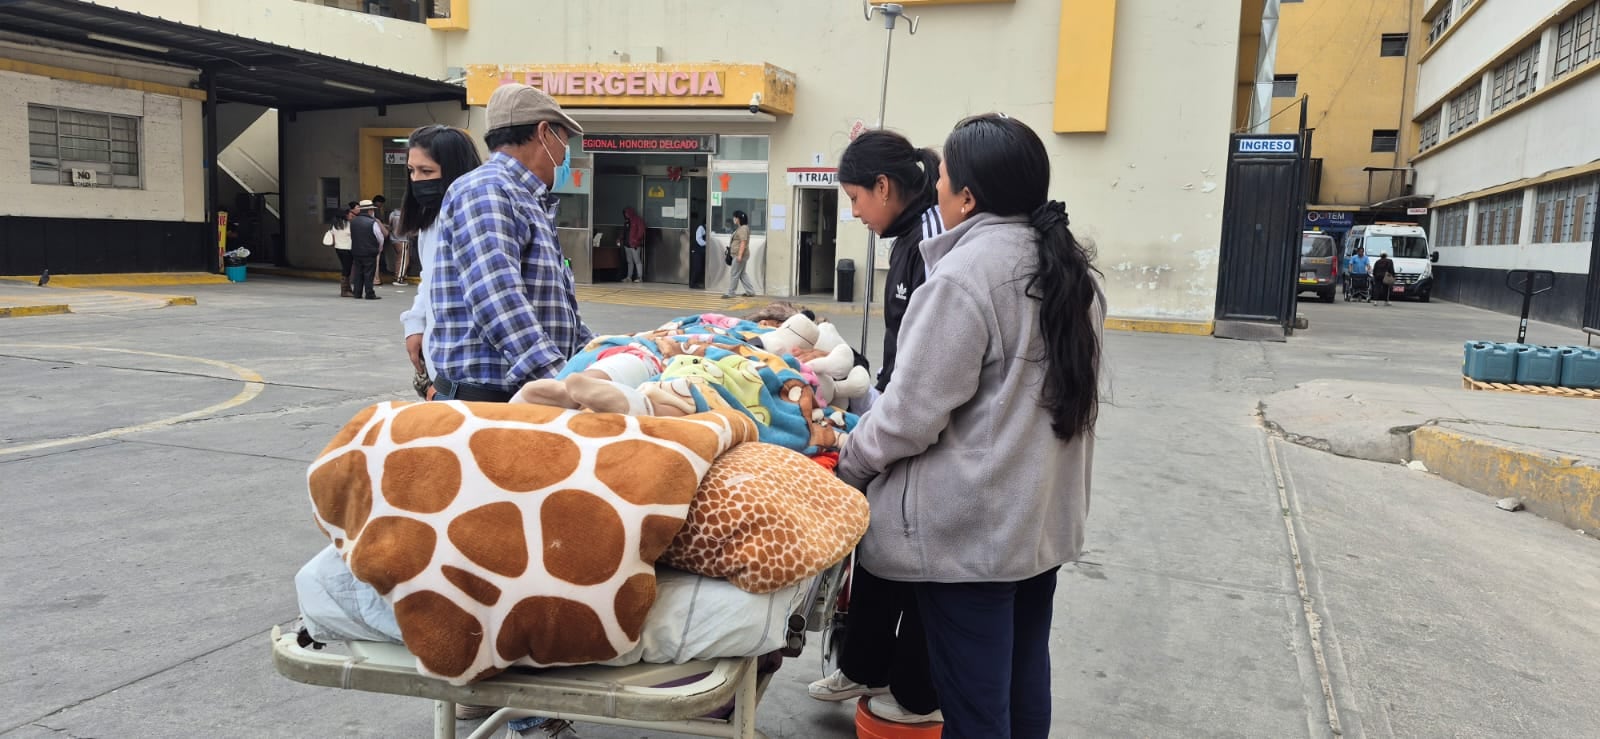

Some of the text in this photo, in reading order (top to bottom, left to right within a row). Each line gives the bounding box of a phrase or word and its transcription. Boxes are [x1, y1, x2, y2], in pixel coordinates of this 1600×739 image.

[525, 71, 723, 96] EMERGENCIA
[619, 139, 657, 149] HONORIO
[659, 139, 698, 149] DELGADO
[1241, 141, 1292, 150] INGRESO
[77, 171, 91, 180] NO
[712, 194, 721, 205] 4
